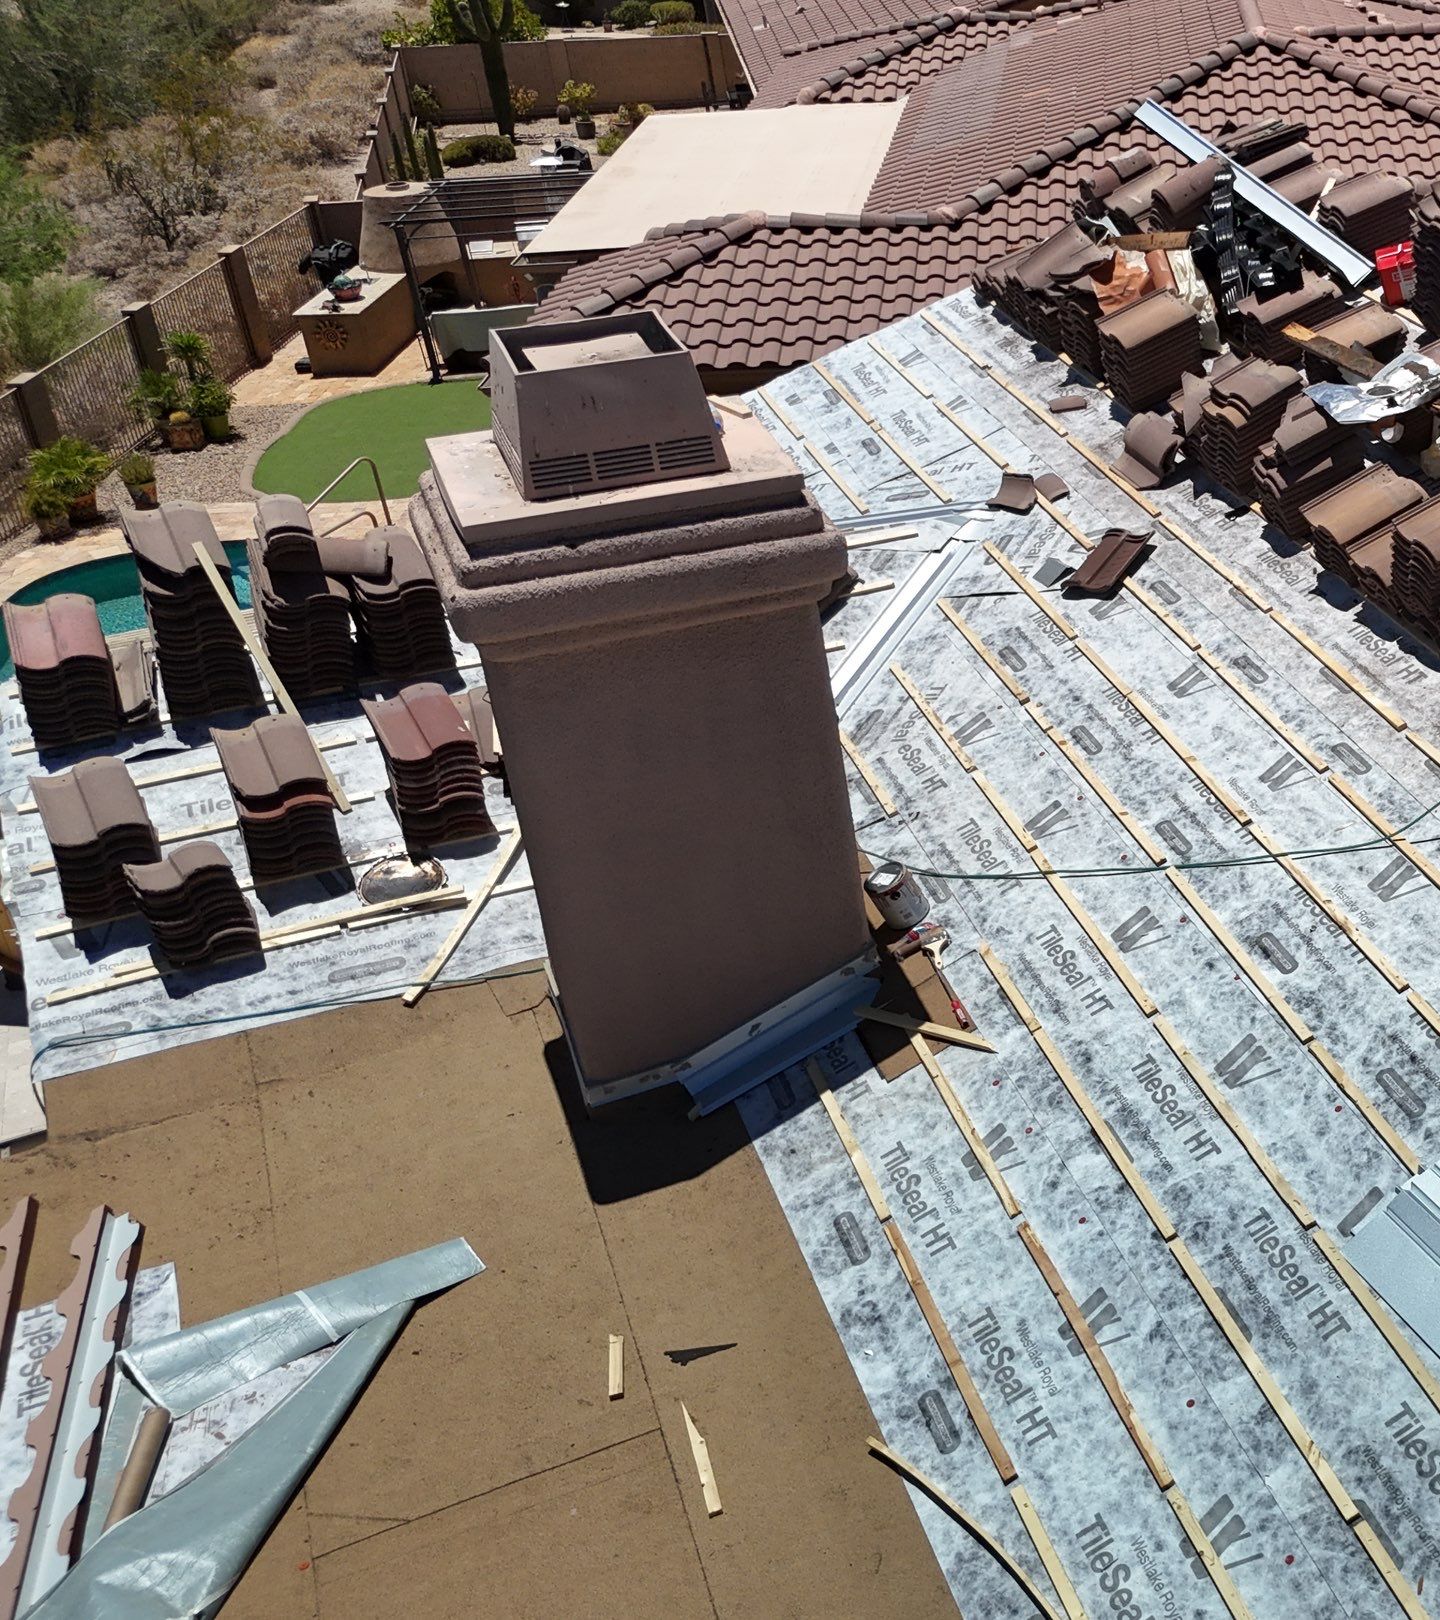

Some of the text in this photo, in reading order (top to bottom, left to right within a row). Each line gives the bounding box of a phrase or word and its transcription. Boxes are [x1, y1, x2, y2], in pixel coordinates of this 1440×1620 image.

[1394, 660, 1429, 685] HT
[920, 772, 949, 795] HT
[180, 797, 233, 819] Tile
[15, 821, 46, 836] Roya
[1355, 909, 1378, 931] Royal
[35, 967, 95, 987] Westlake
[1079, 986, 1115, 1017] HT
[1182, 1126, 1223, 1163] HT
[922, 1153, 963, 1216] Westlake Royal
[920, 1221, 958, 1258] HT
[1306, 1299, 1353, 1343] HT
[1016, 1323, 1062, 1398] Westlake Royal
[1015, 1404, 1059, 1447] HT
[1075, 1512, 1155, 1620] TileSea
[1130, 1535, 1183, 1620] Westlake Roy
